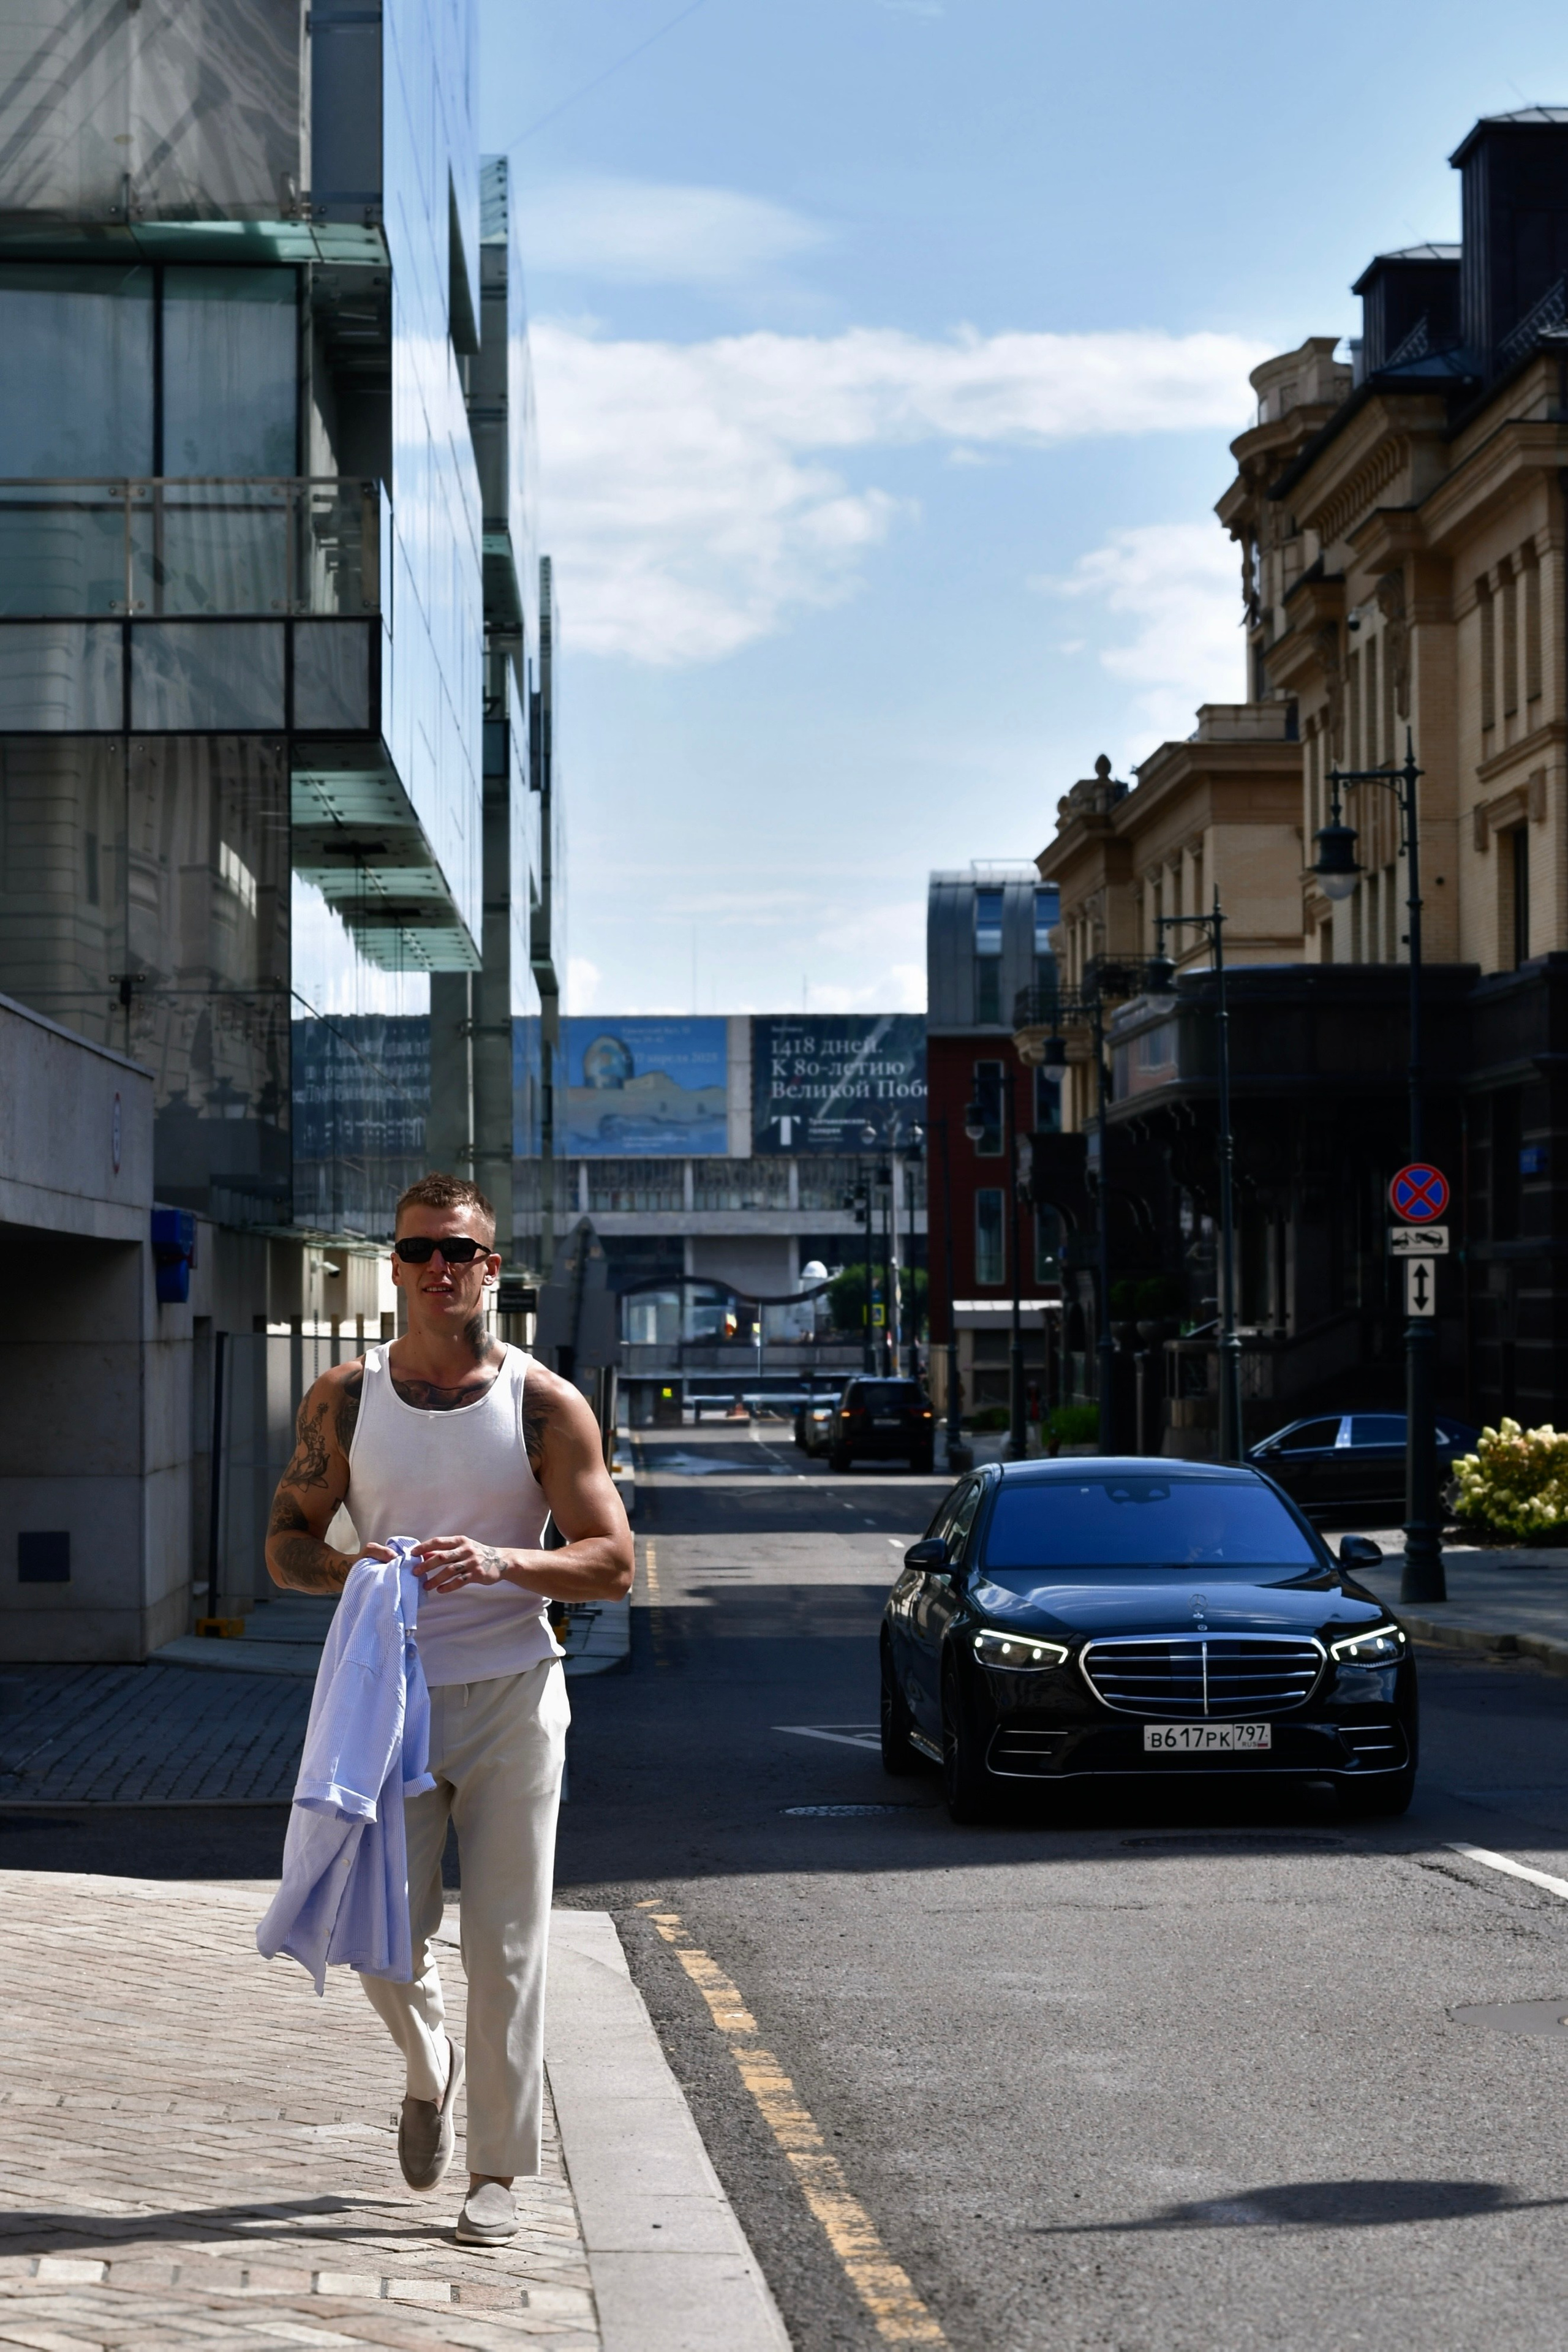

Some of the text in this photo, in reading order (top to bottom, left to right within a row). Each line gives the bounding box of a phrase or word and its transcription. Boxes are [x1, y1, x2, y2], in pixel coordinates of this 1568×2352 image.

[772, 1036, 883, 1057] 1418 дней.
[772, 1058, 905, 1076] К 80-летию
[772, 1079, 869, 1099] Великой
[1235, 1725, 1265, 1741] 797
